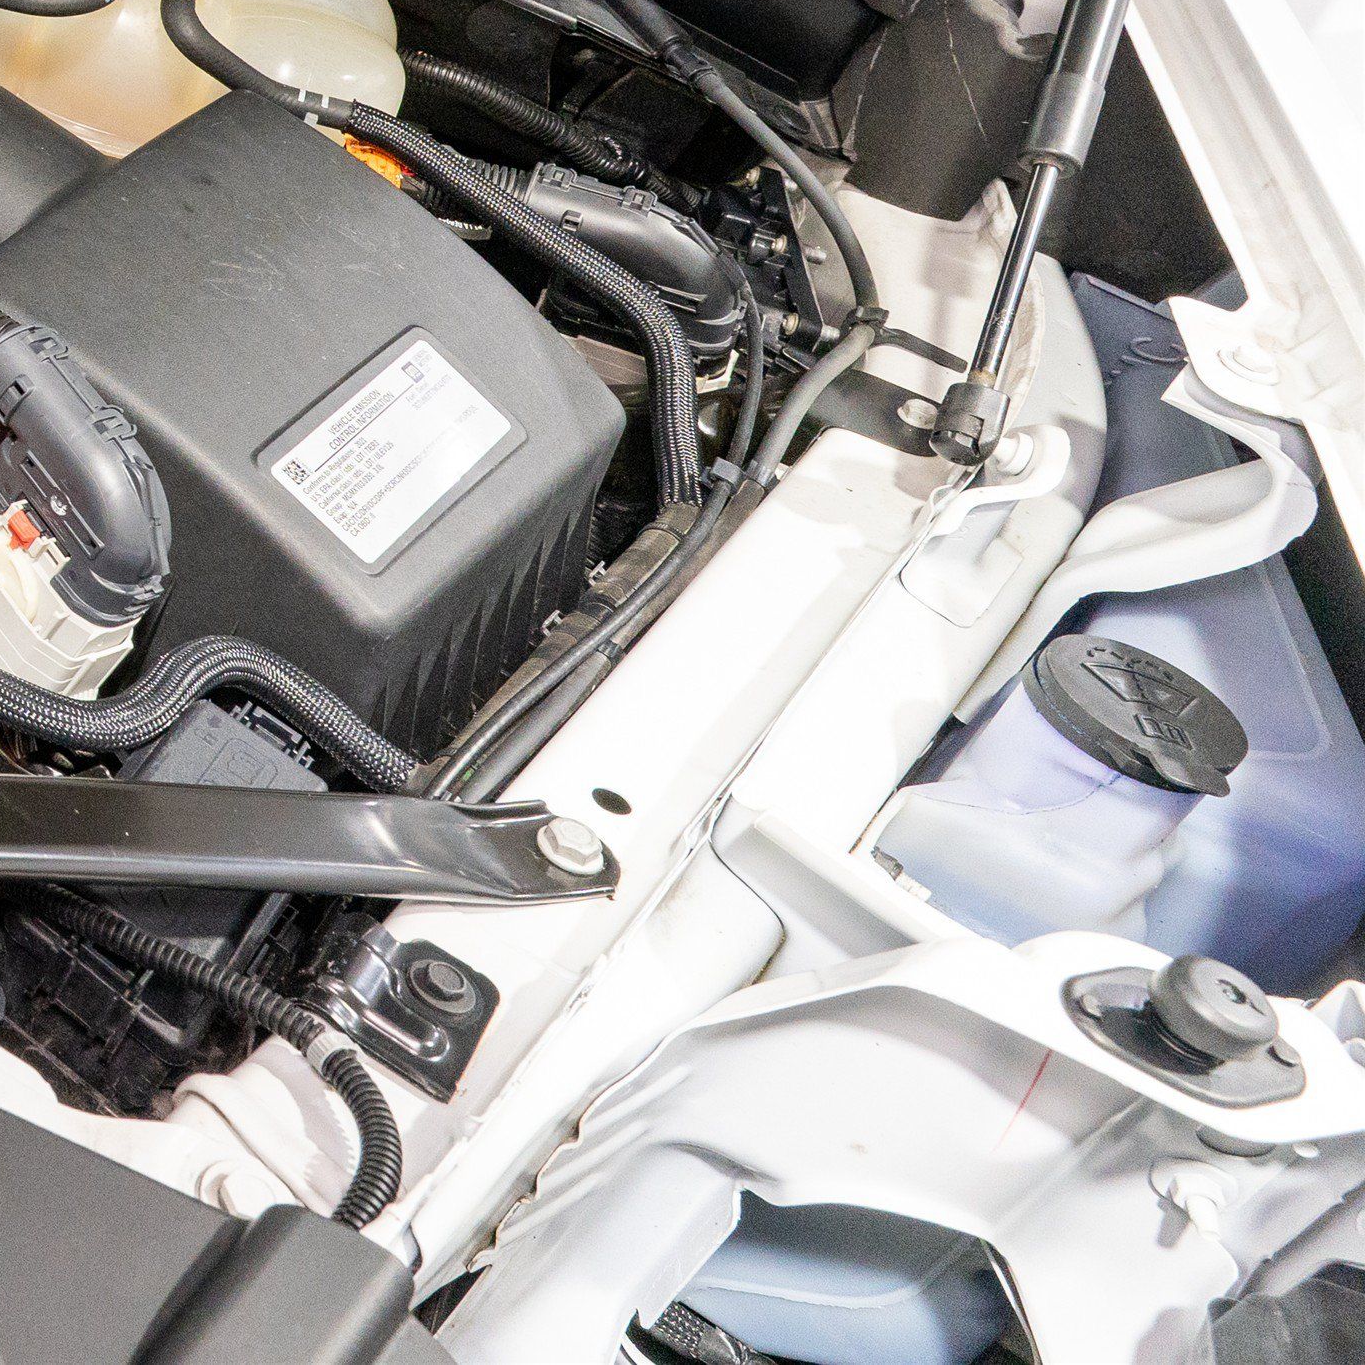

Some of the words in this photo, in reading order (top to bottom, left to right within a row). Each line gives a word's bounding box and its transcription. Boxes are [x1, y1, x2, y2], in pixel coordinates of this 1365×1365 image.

[328, 411, 356, 435] VEHICLE
[351, 390, 381, 415] EMISSION
[329, 424, 360, 450] CONTROL
[355, 393, 395, 425] INFORMATION
[319, 483, 332, 494] EPA
